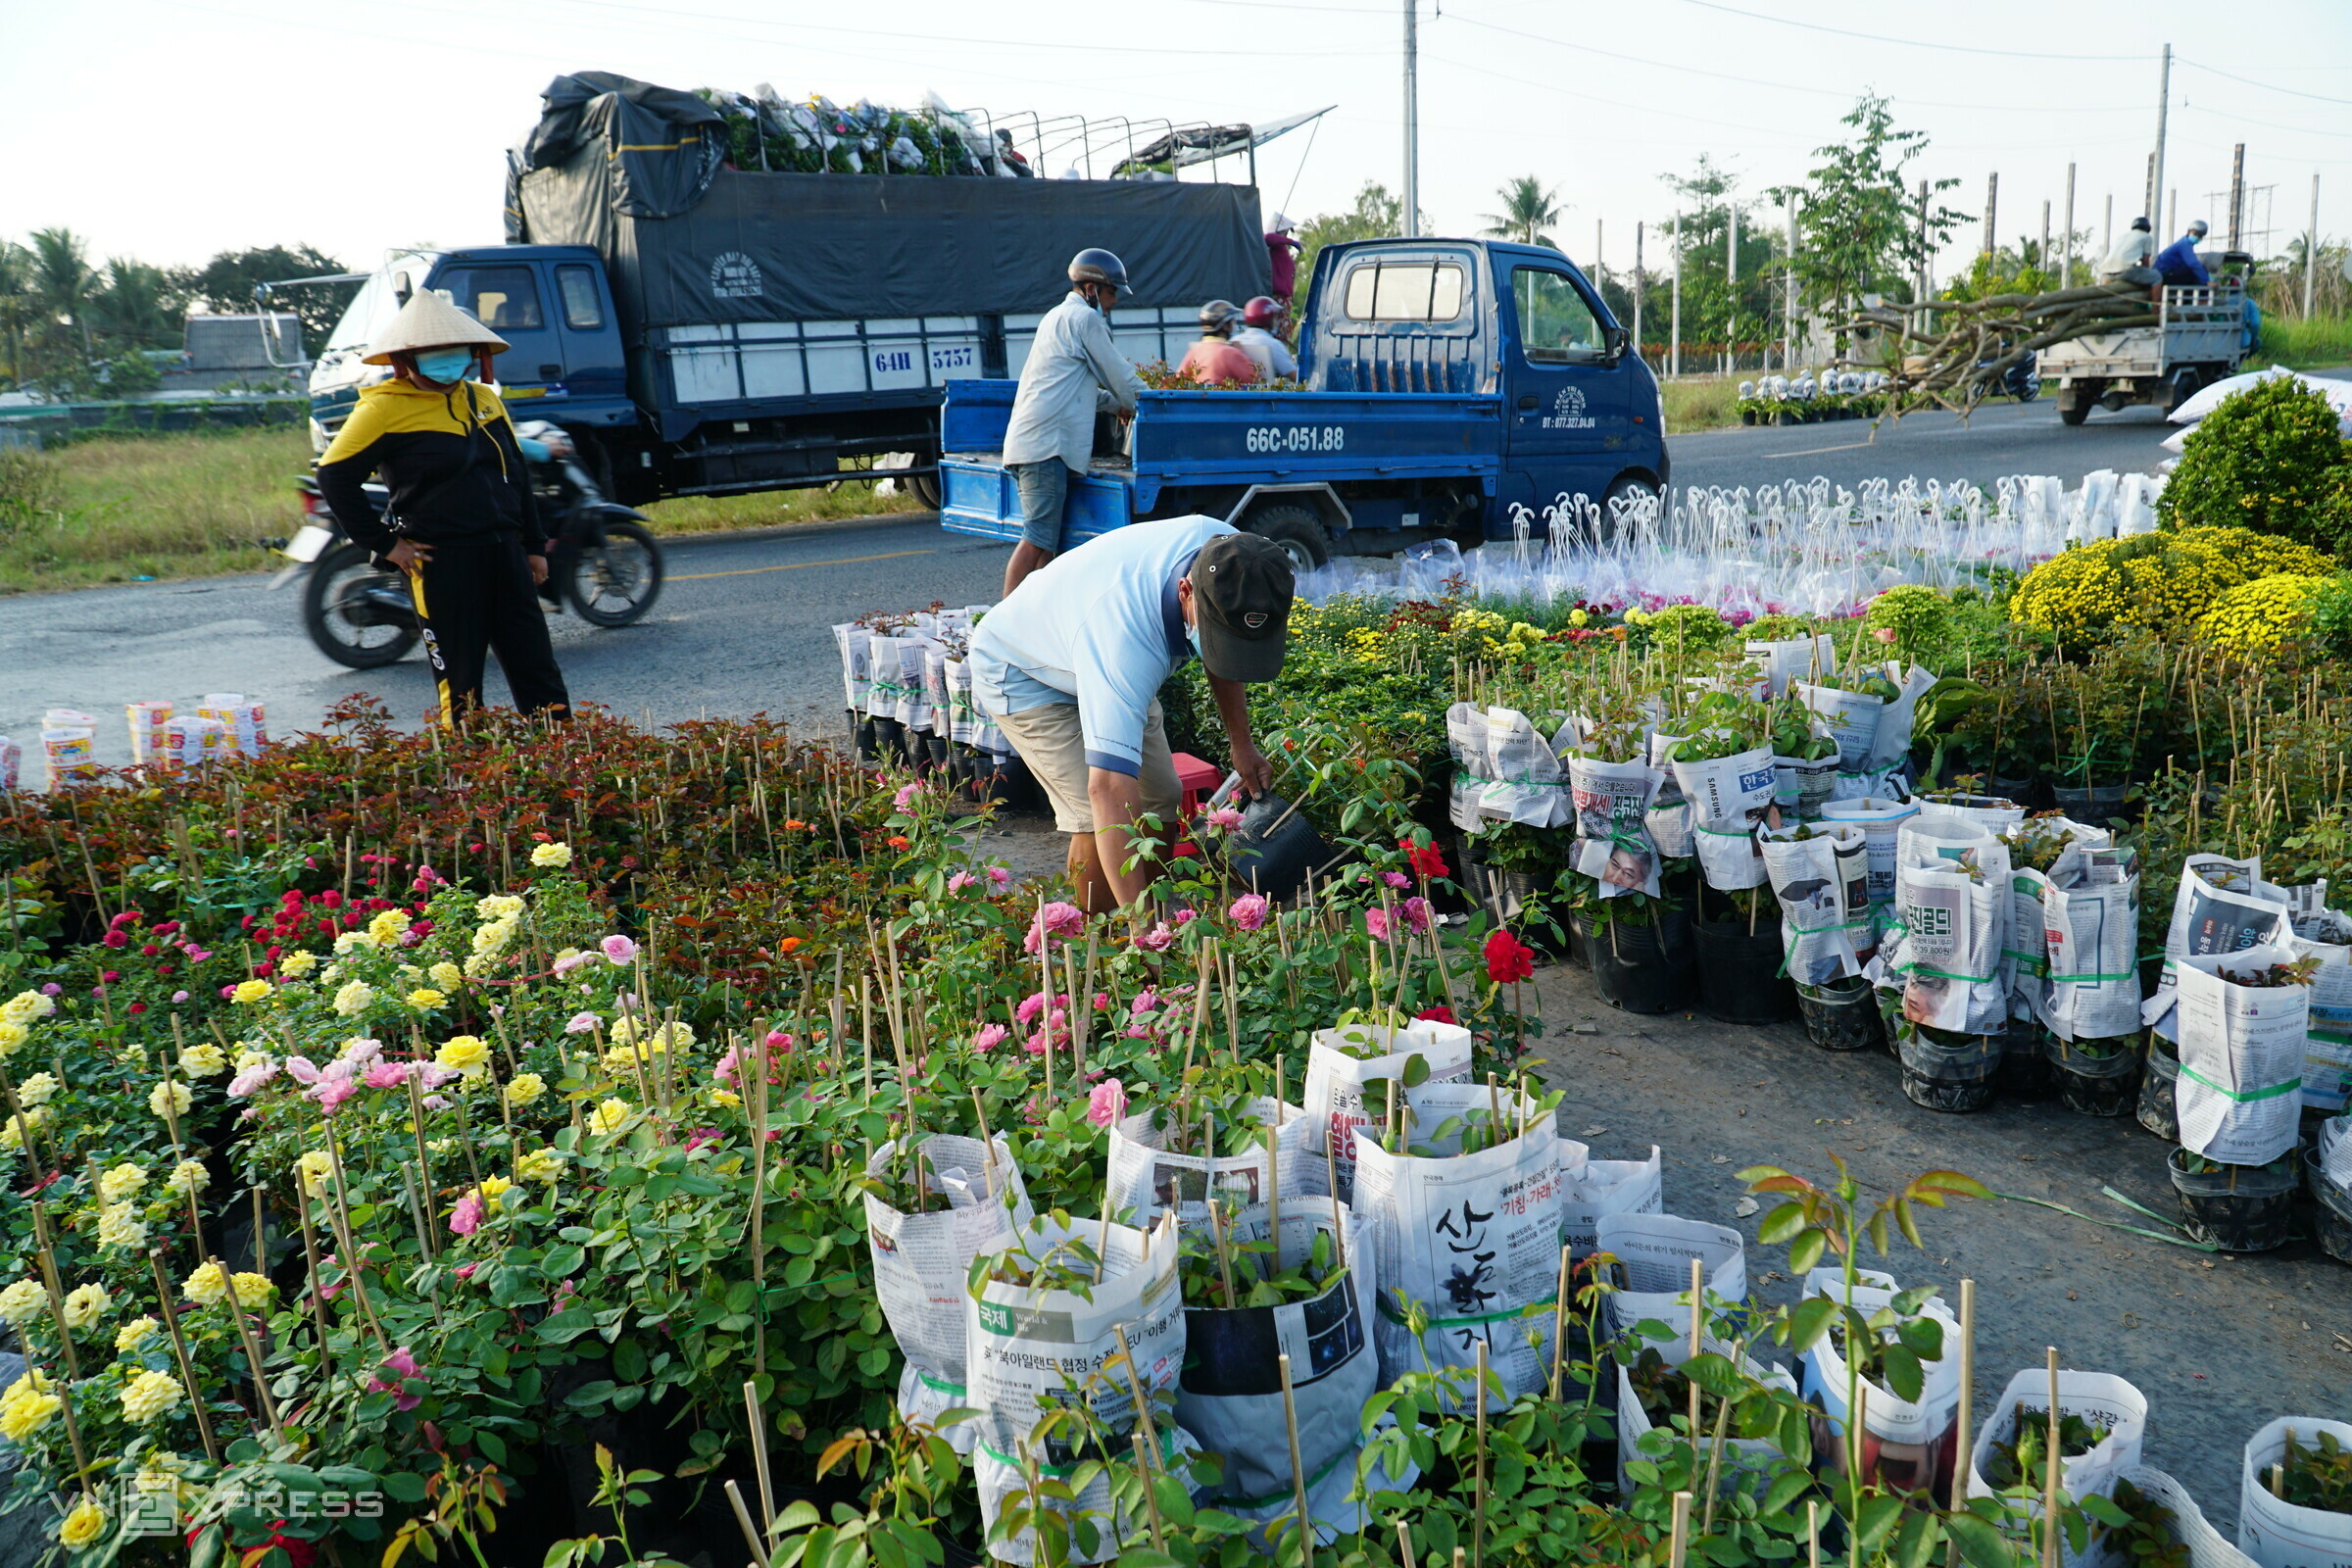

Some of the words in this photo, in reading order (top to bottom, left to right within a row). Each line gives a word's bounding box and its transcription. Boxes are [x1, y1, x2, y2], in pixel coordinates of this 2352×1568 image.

[875, 351, 912, 372] 64H
[933, 347, 972, 368] 5757
[1247, 426, 1345, 453] 66C-051.88
[1708, 777, 1722, 818] SAMSUNG
[980, 1305, 1007, 1330] 국제
[1016, 1313, 1040, 1324] World
[1061, 1357, 1088, 1373] 협정
[1126, 1333, 1141, 1350] EU
